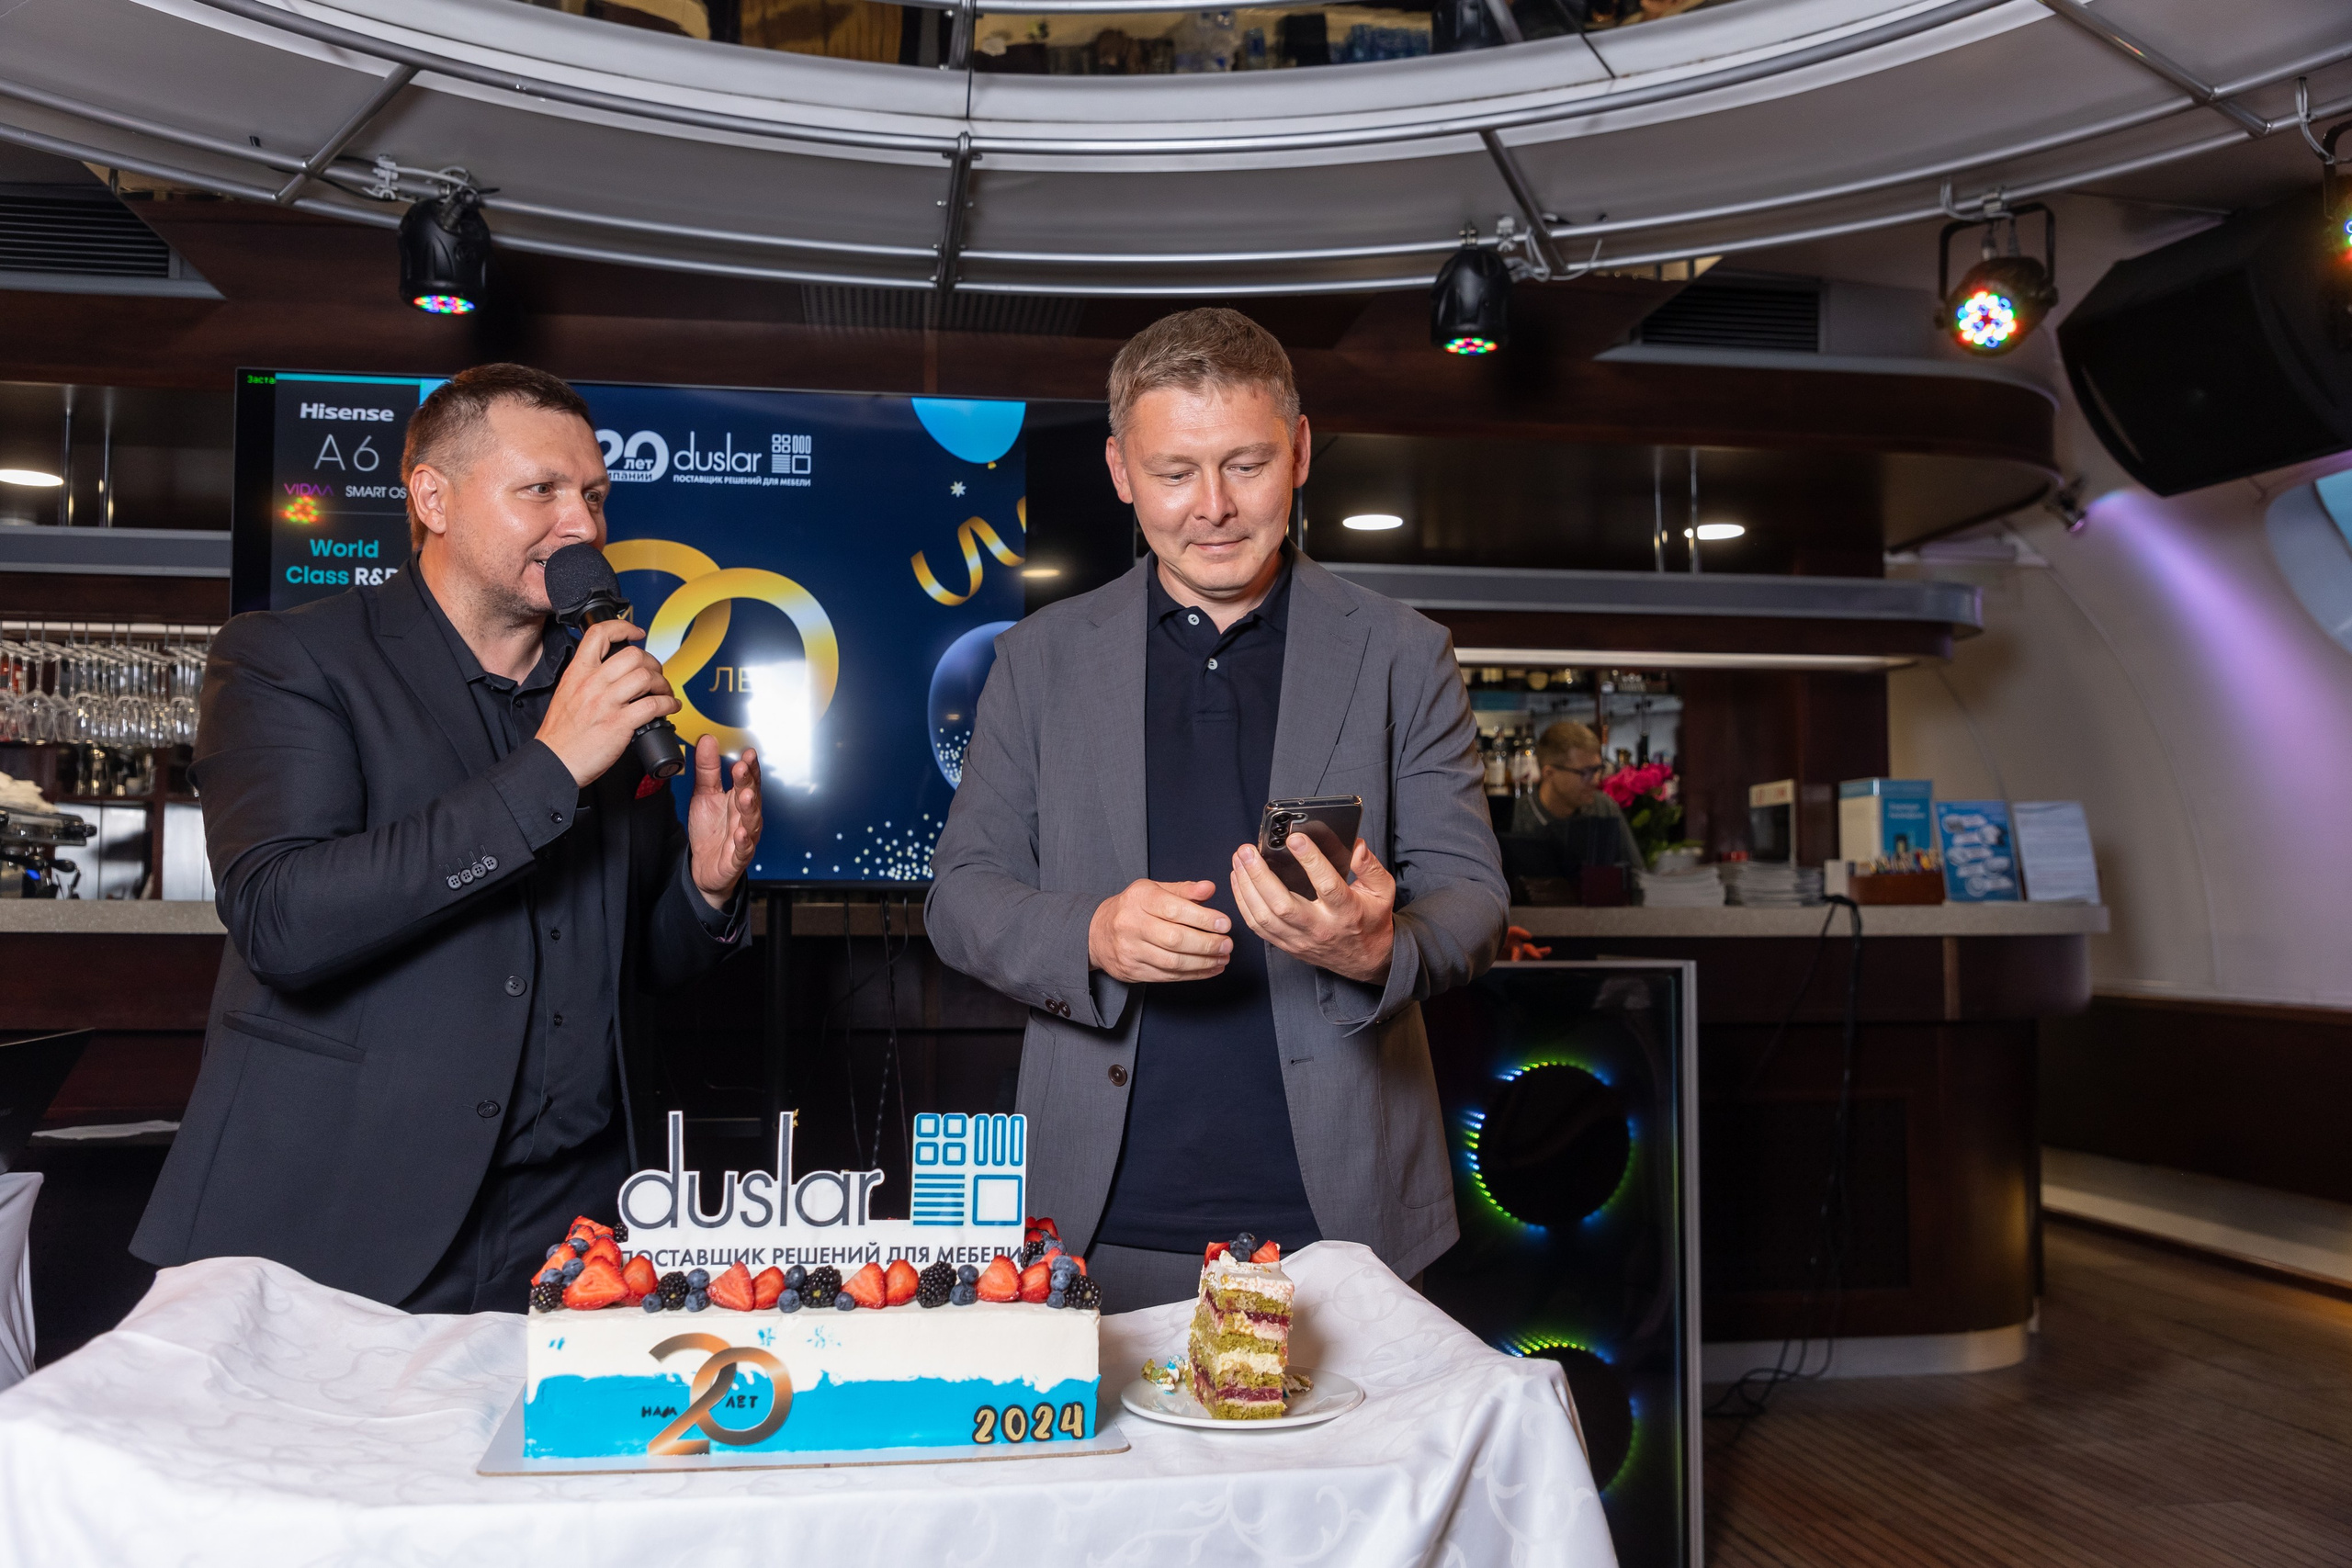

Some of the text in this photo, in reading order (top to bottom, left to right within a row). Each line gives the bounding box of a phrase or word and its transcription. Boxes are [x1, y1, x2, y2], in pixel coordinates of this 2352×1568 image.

[247, 374, 276, 385] Заста
[300, 401, 395, 423] Hisense
[595, 428, 670, 483] 20
[673, 430, 763, 473] duslar
[624, 457, 654, 470] лет
[345, 485, 388, 498] SMART
[389, 486, 407, 500] OS
[673, 474, 811, 488] ПОСТАВЩИК РЕШЕНИЙ ДЛЯ МЕБЕЛИ
[310, 538, 379, 558] World
[286, 565, 349, 585] Class
[708, 666, 757, 694] ЛЕ
[620, 1112, 885, 1231] duslar
[773, 1242, 880, 1266] РЕШЕНИЙ
[886, 1246, 930, 1266] ДЛЯ
[647, 1332, 793, 1456] 20
[725, 1394, 759, 1409] ЛЕТ
[972, 1401, 1085, 1444] 2024
